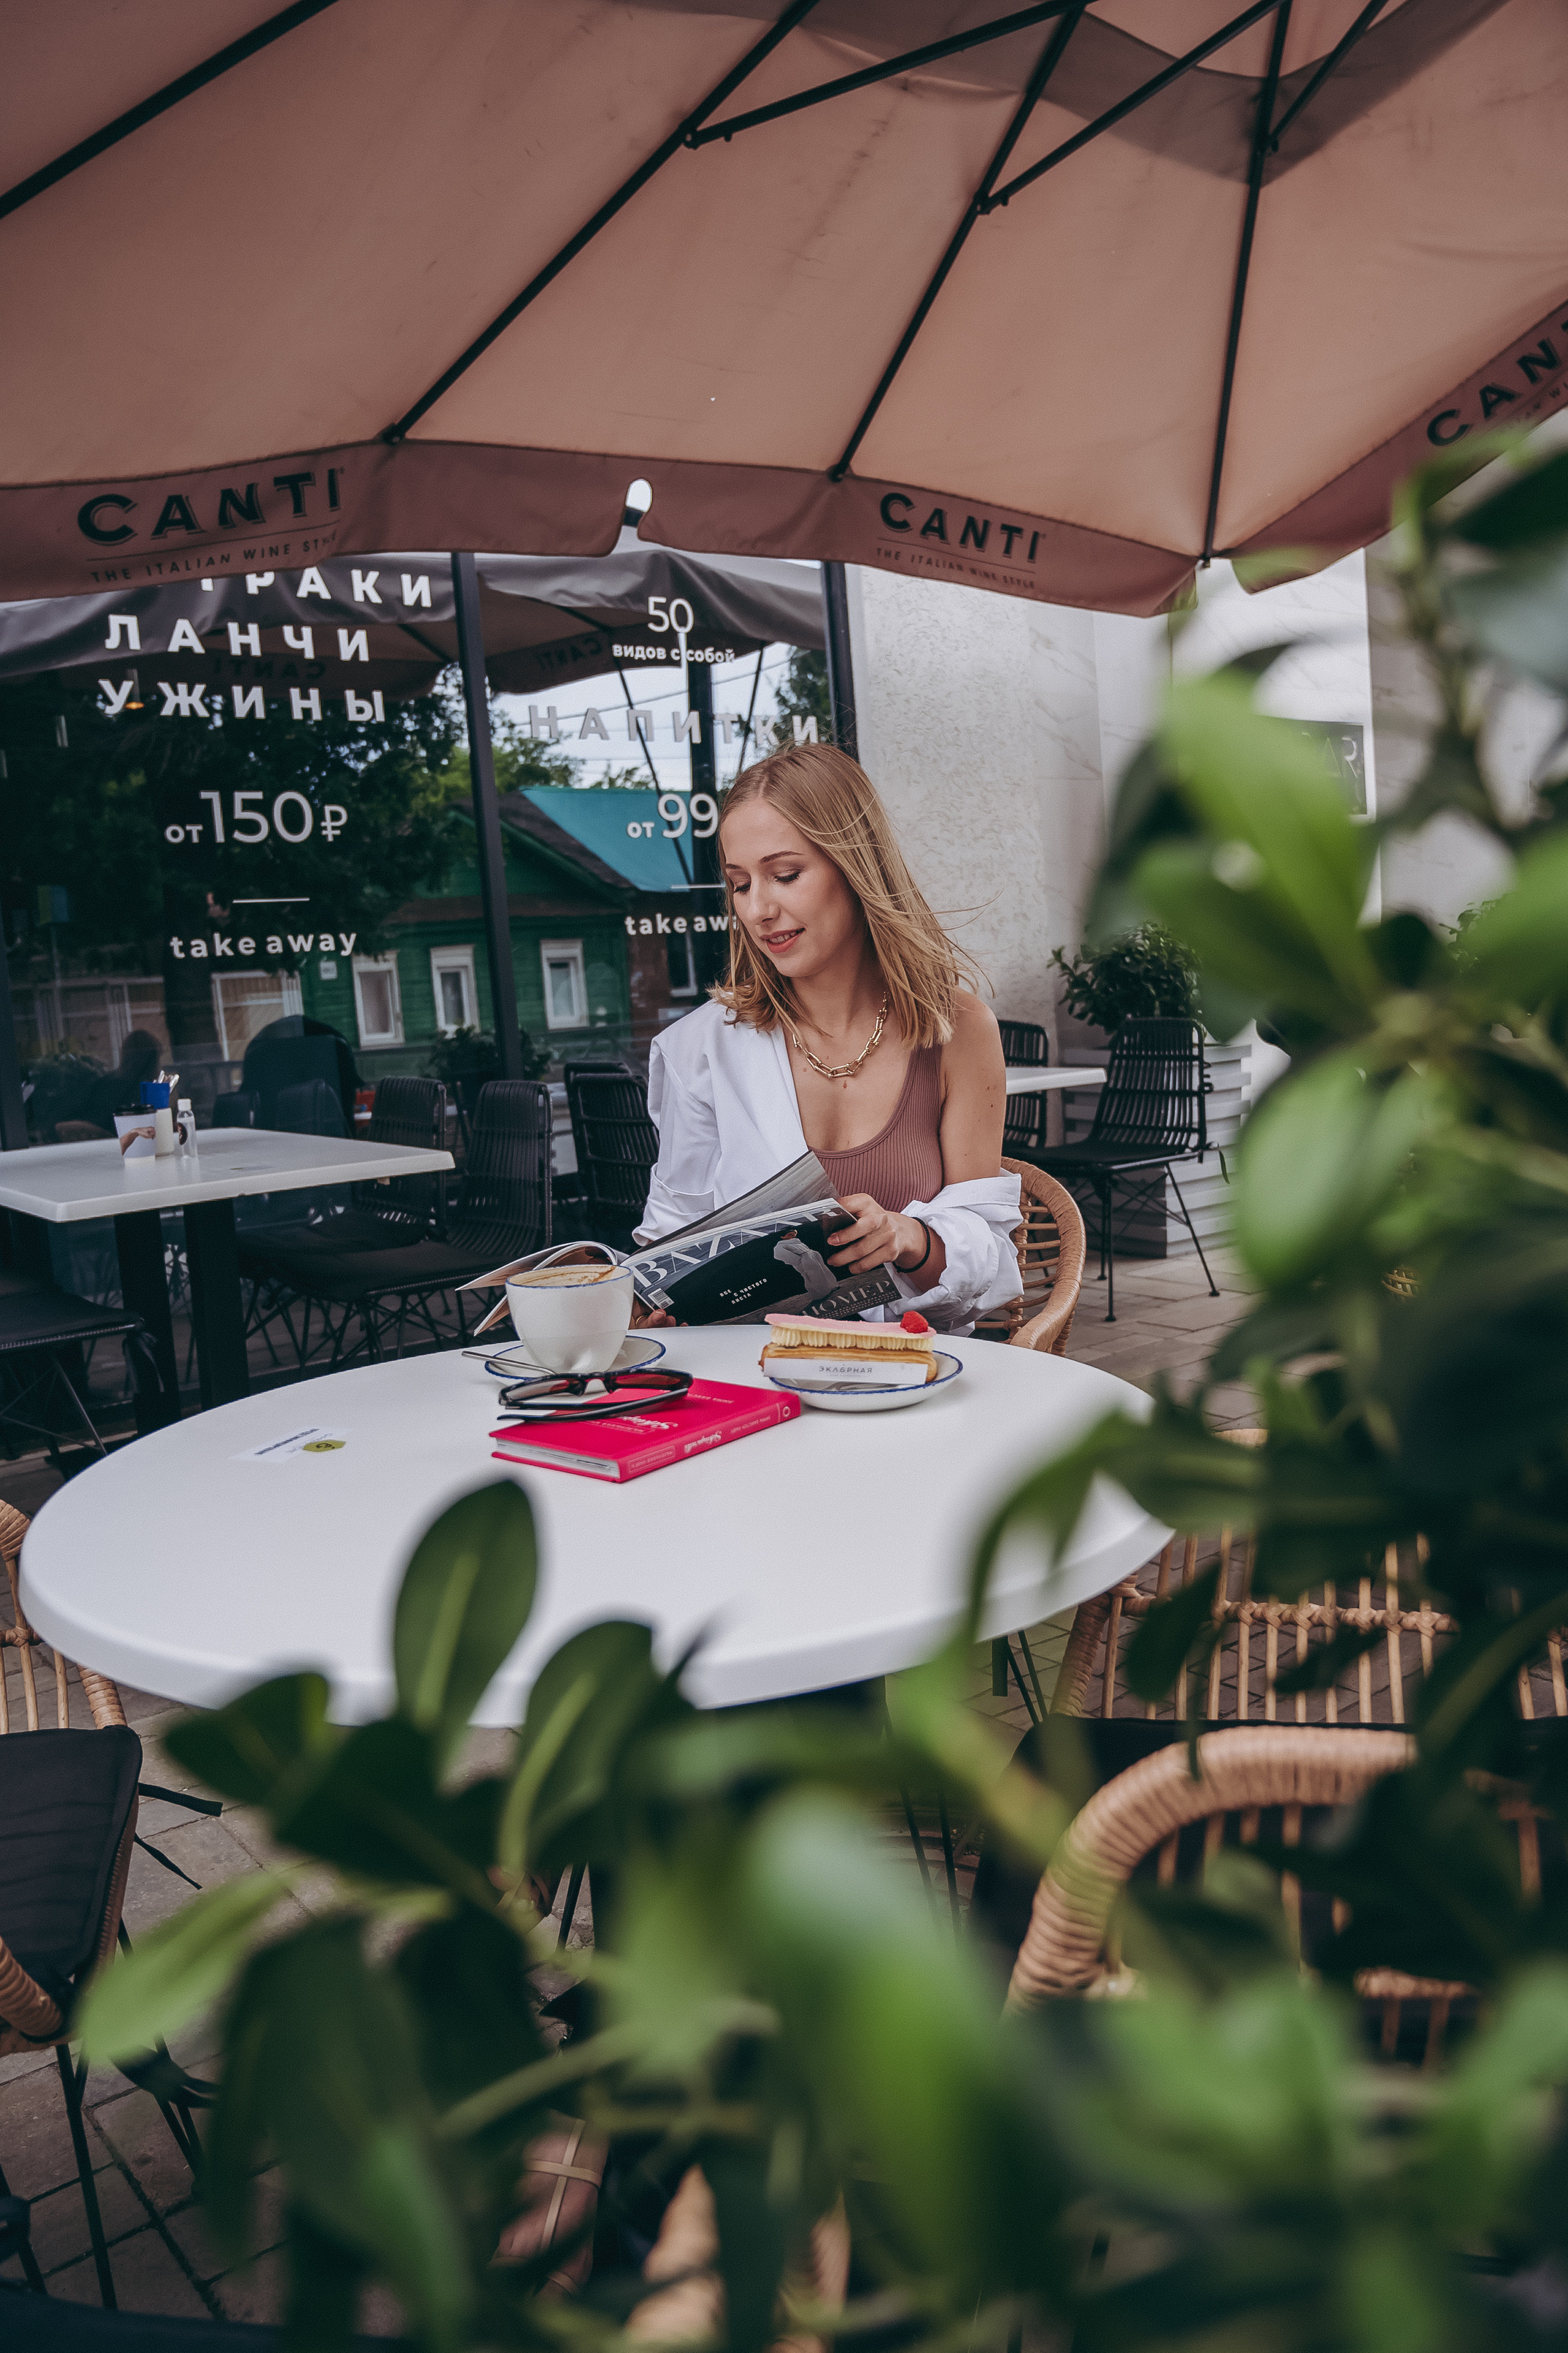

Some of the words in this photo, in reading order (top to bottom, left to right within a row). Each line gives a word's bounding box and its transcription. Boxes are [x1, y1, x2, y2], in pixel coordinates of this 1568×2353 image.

[77, 467, 341, 545] CANTI
[880, 492, 1041, 563] CANTI
[91, 569, 131, 583] THE
[146, 553, 231, 576] ITALIAN
[244, 543, 291, 560] WINE
[876, 548, 902, 560] THE
[911, 554, 963, 571] ITALIAN
[1003, 574, 1035, 589] STYLE
[647, 596, 695, 633] 50
[104, 614, 369, 662] ЛАНЧИ
[612, 644, 667, 660] видов
[685, 646, 735, 663] собой
[97, 679, 385, 723] УЖИНЫ
[529, 704, 820, 747] НАПИТКИ
[164, 824, 203, 843] от
[627, 821, 655, 838] от
[657, 793, 718, 838] 99
[170, 932, 257, 958] take
[266, 932, 357, 957] away
[624, 913, 688, 936] take
